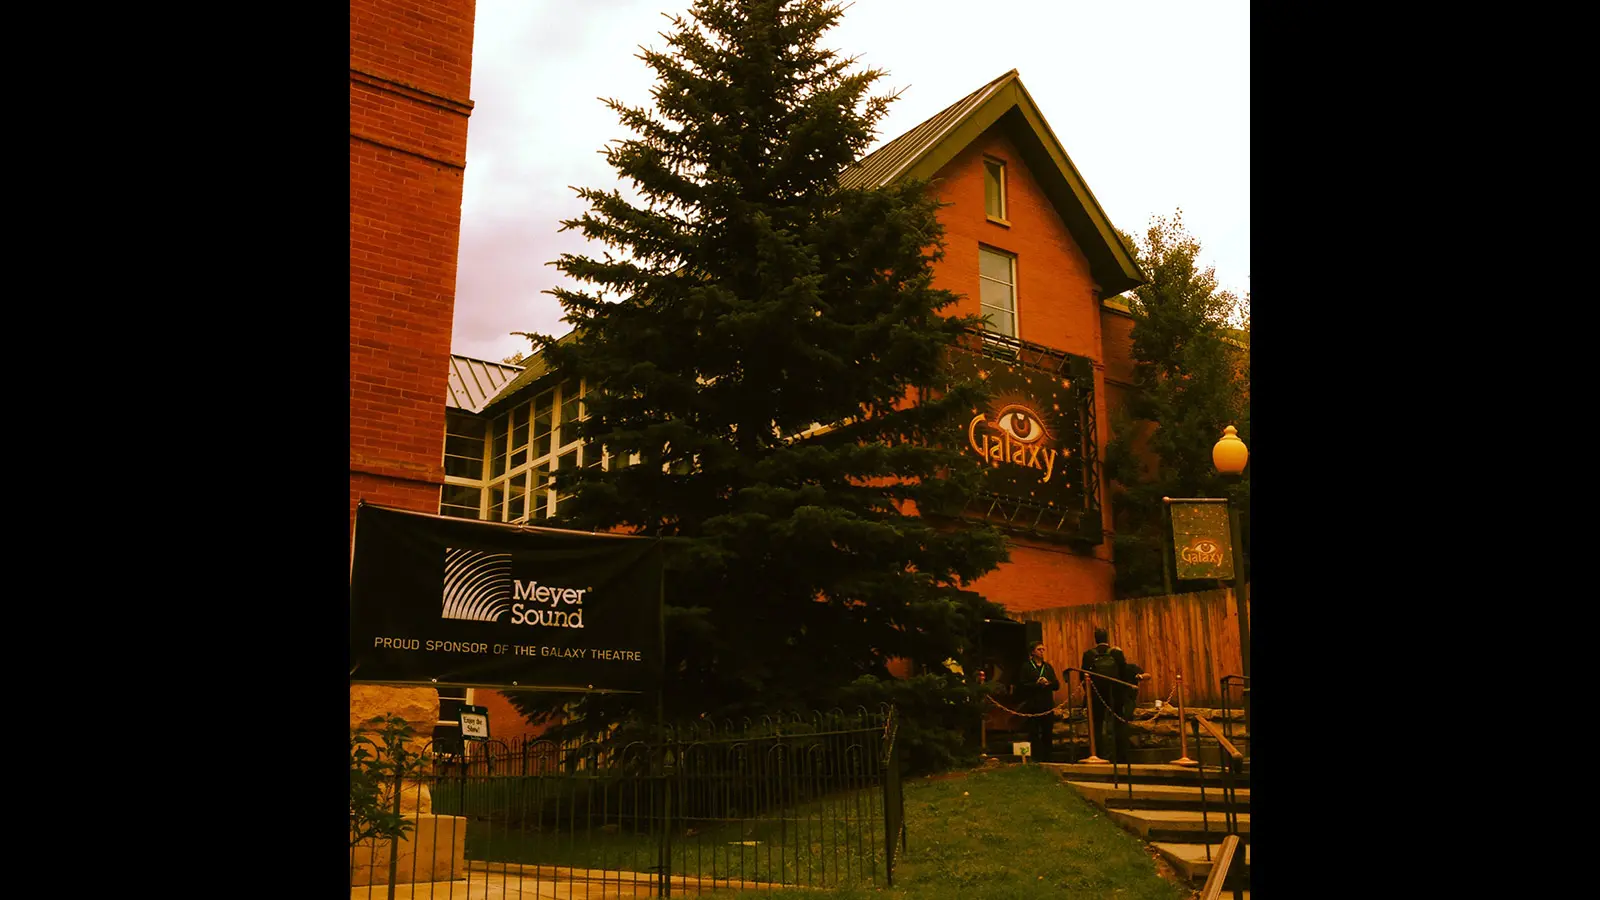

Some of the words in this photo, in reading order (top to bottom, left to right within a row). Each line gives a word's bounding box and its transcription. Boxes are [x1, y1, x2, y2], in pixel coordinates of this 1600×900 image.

[968, 413, 1056, 483] Galaxy
[1181, 547, 1224, 567] Galaxy
[512, 579, 587, 607] Meyer
[510, 603, 585, 629] Sound
[374, 636, 420, 650] PROUD
[425, 640, 488, 654] SPONSOR
[493, 644, 509, 655] OF
[513, 645, 536, 657] THE
[541, 646, 586, 659] GALAXY
[591, 648, 641, 661] THEATRE
